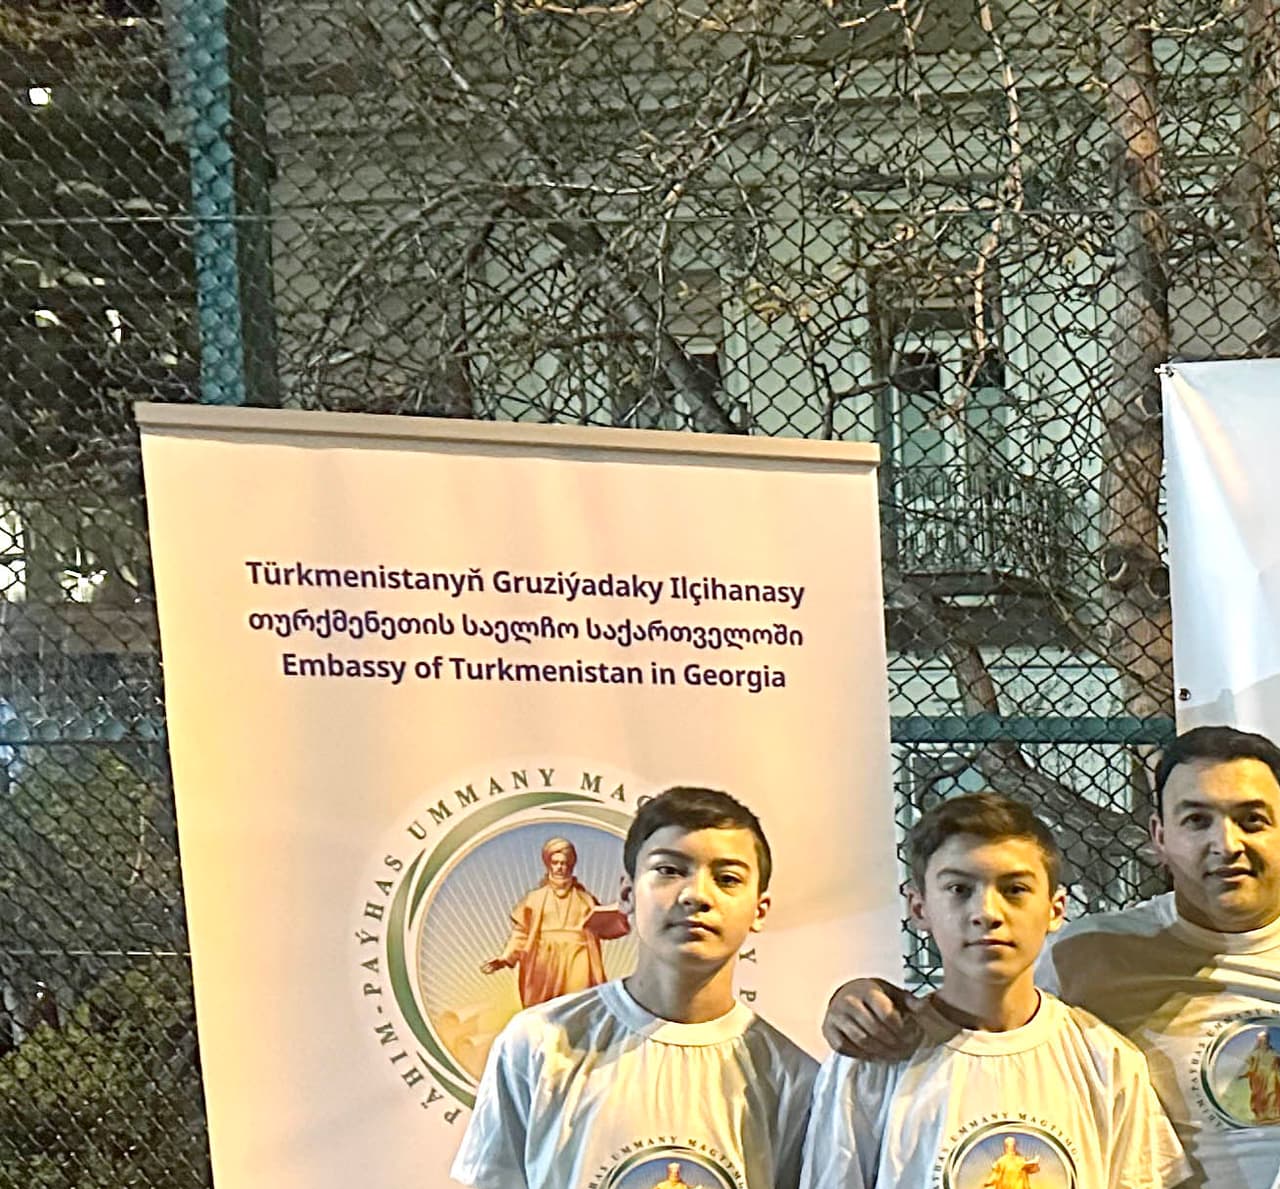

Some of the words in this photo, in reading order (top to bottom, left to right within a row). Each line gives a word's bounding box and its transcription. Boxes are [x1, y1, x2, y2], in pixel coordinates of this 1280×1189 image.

[244, 561, 485, 599] Türkmenistanyň
[492, 570, 664, 606] Gruziýadaky
[669, 575, 806, 610] Ilçihanasy
[248, 607, 455, 641] თურქმენეთის
[461, 613, 580, 645] საელჩო
[585, 617, 804, 651] საქართველოში
[282, 652, 407, 686] Embassy
[414, 655, 444, 680] of
[448, 656, 644, 685] Turkmenistan
[650, 661, 676, 686] in
[683, 663, 786, 694] Georgia
[406, 768, 555, 842] UMMANY
